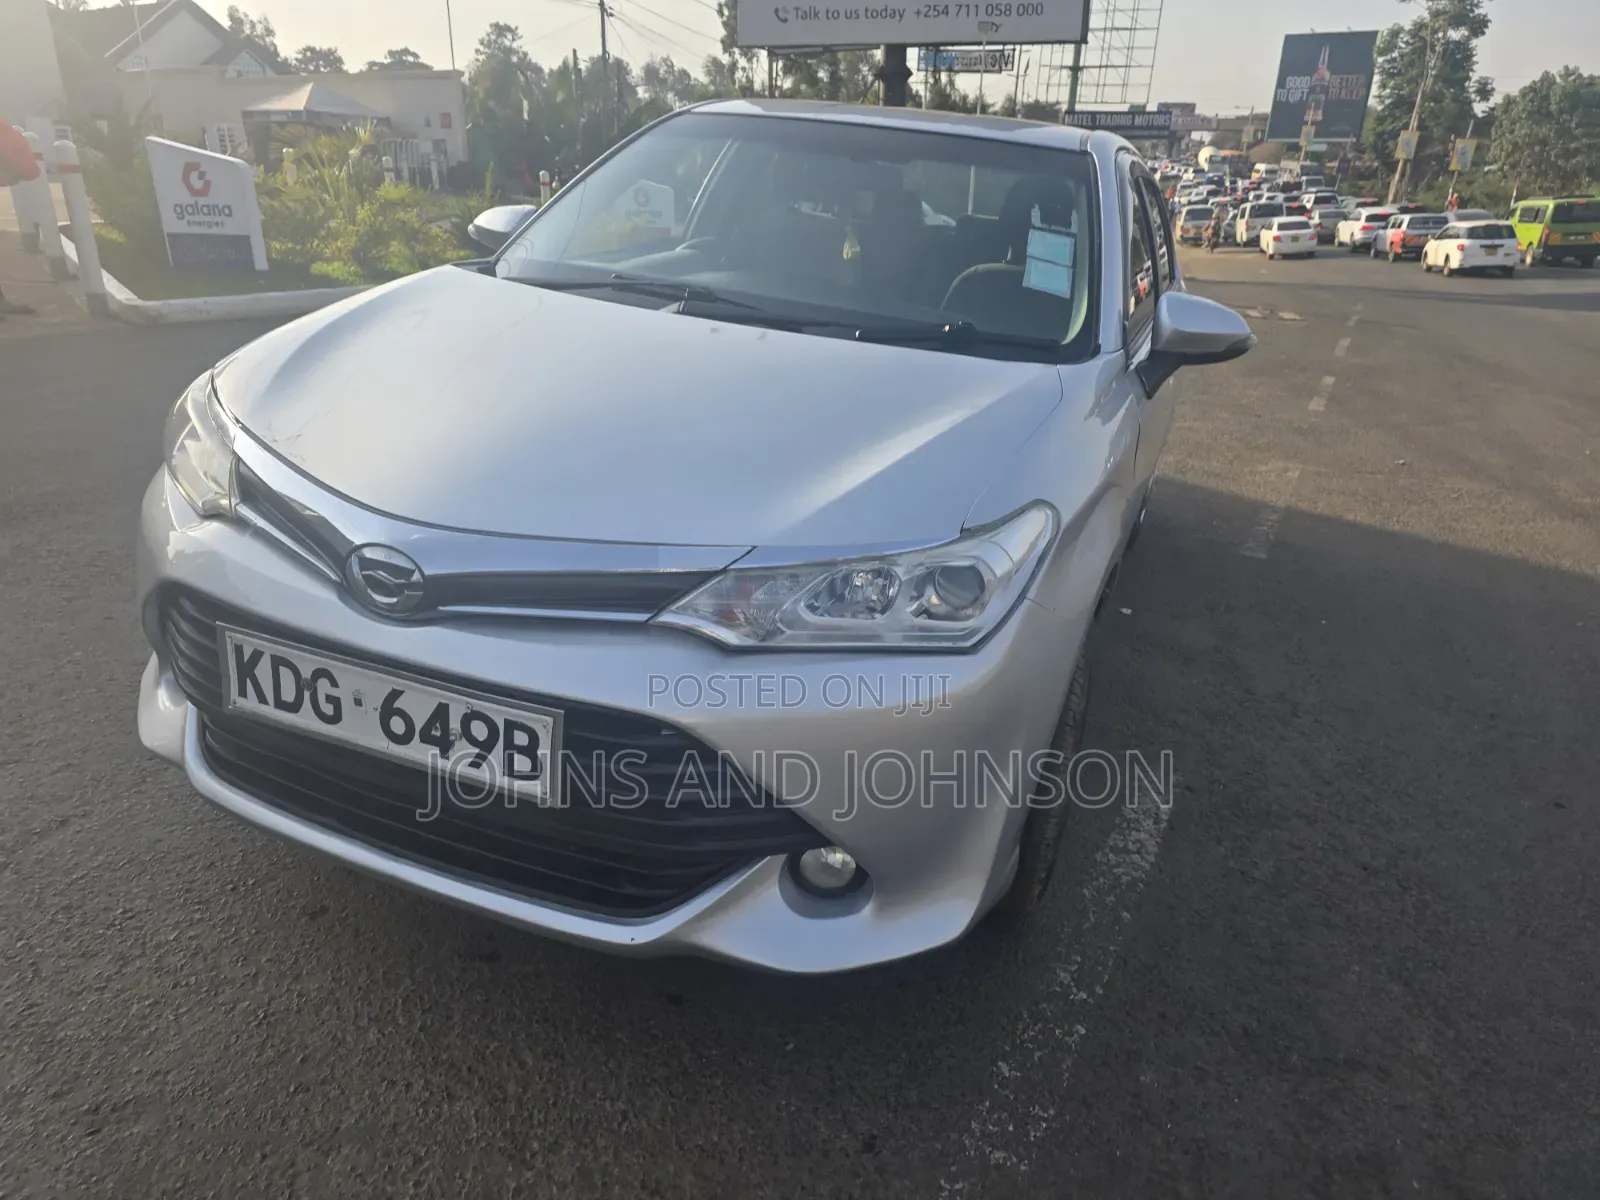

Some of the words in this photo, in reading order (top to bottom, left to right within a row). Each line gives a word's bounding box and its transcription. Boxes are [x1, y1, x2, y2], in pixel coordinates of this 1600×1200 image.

[793, 5, 821, 20] Talk
[825, 7, 840, 20] to
[844, 8, 860, 20] us
[864, 4, 906, 23] today
[914, 4, 950, 18] +254
[955, 4, 979, 17] 711
[985, 3, 1012, 17] 058
[1016, 2, 1044, 16] 000
[1286, 76, 1311, 88] GOOD
[1330, 74, 1366, 87] BETTER
[1277, 89, 1288, 101] TO
[1288, 89, 1310, 103] GIFT
[1064, 114, 1092, 126] MATEL
[1096, 114, 1132, 126] TRADING
[1134, 114, 1170, 127] MOTORS
[173, 200, 233, 220] galana
[186, 219, 225, 229] energies
[233, 643, 343, 725] KDG
[379, 687, 543, 781] 649B
